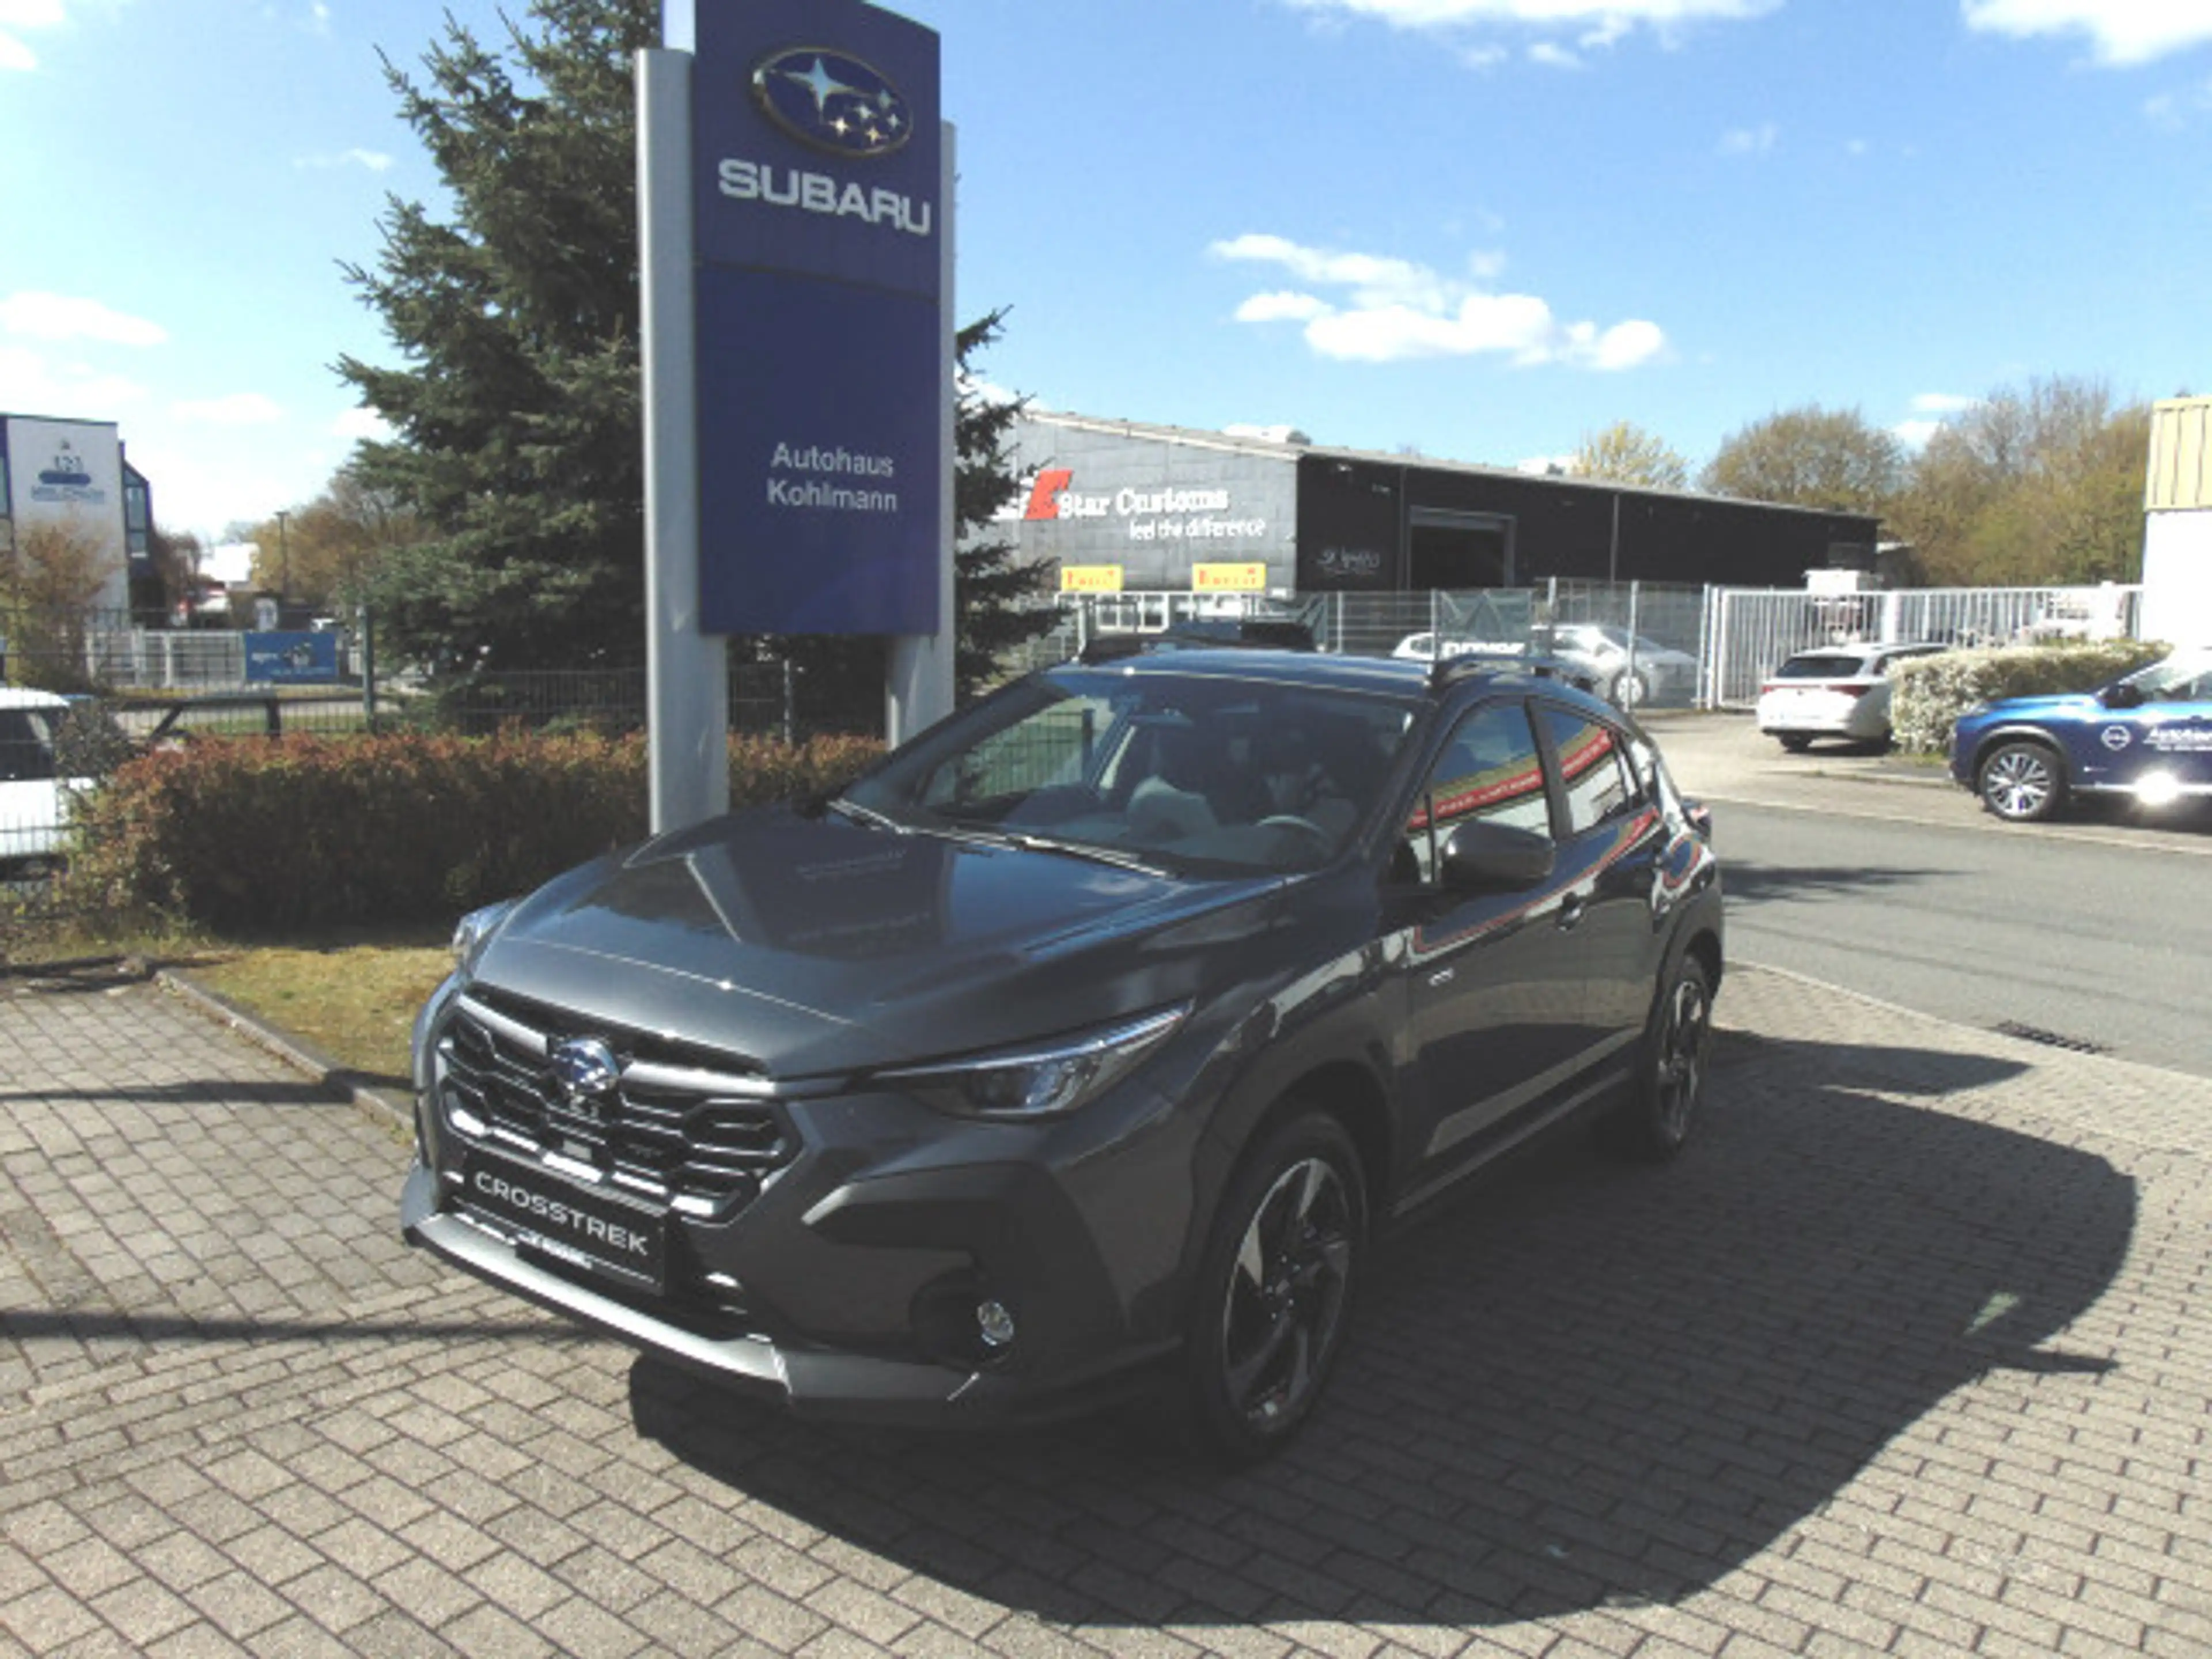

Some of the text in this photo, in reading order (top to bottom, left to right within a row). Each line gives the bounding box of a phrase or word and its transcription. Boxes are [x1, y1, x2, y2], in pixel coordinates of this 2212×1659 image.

[718, 157, 931, 237] SUBARU
[771, 441, 893, 478] Autohaus
[767, 477, 897, 512] Kohlmann
[1058, 487, 1228, 519] Star Customs
[475, 1171, 648, 1256] CROSSTREK
